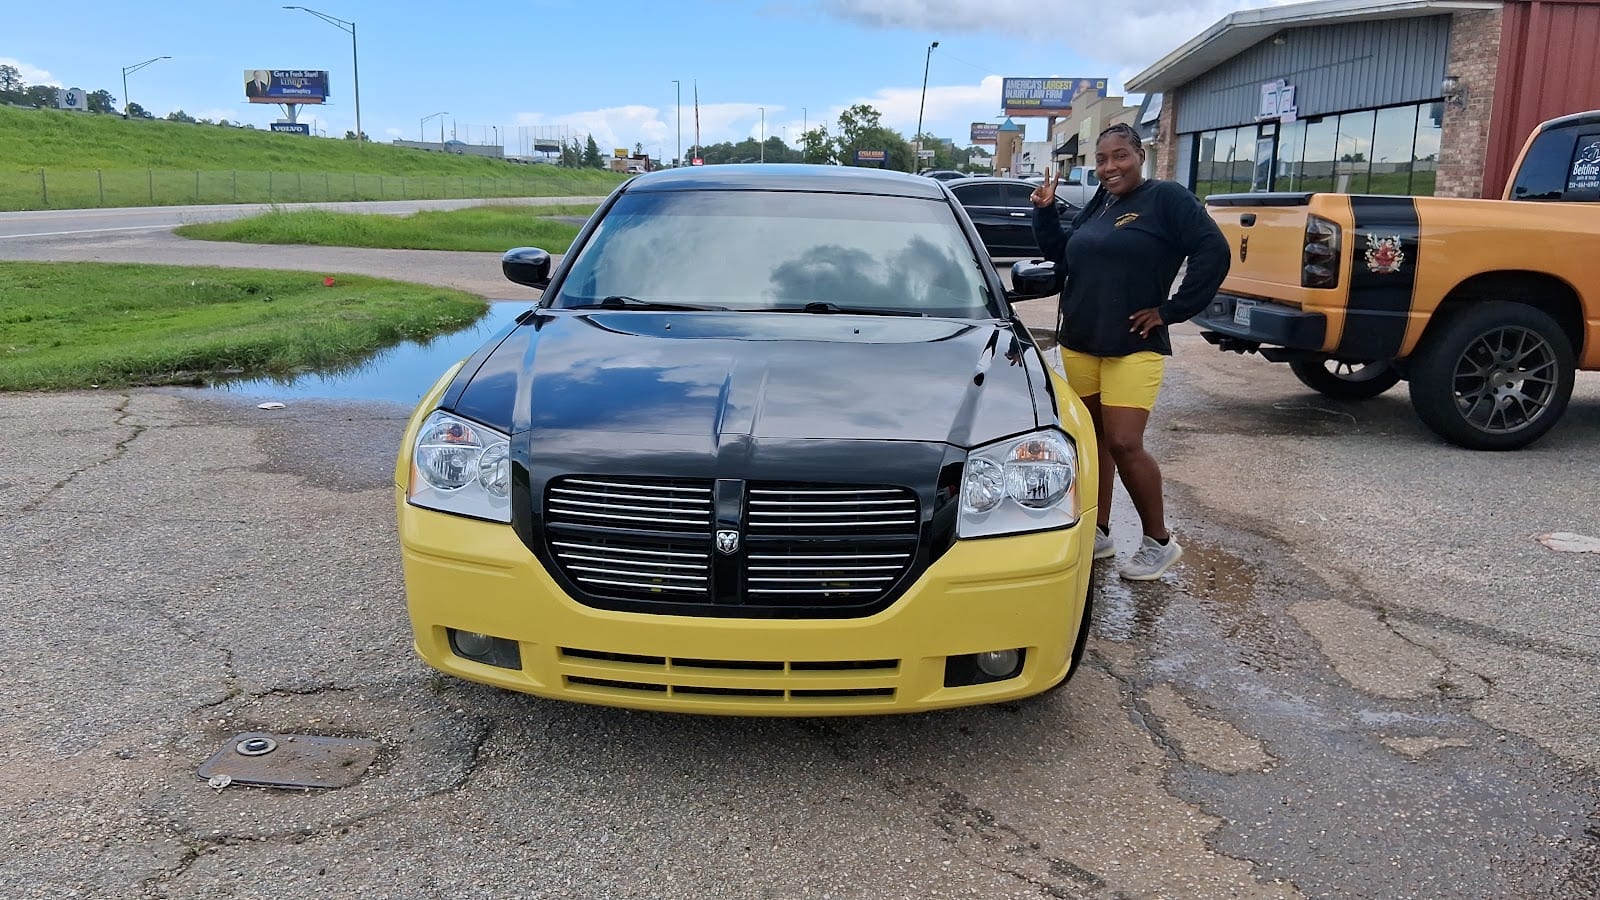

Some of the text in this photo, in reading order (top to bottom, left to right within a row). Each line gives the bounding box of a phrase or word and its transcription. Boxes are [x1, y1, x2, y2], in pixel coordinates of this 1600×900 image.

[273, 70, 284, 78] Get
[289, 70, 303, 78] Fresh
[1006, 80, 1073, 90] AMERICA'S LARGEST
[1005, 89, 1063, 99] INJURY LAW FIRM
[1572, 163, 1600, 176] Beltline
